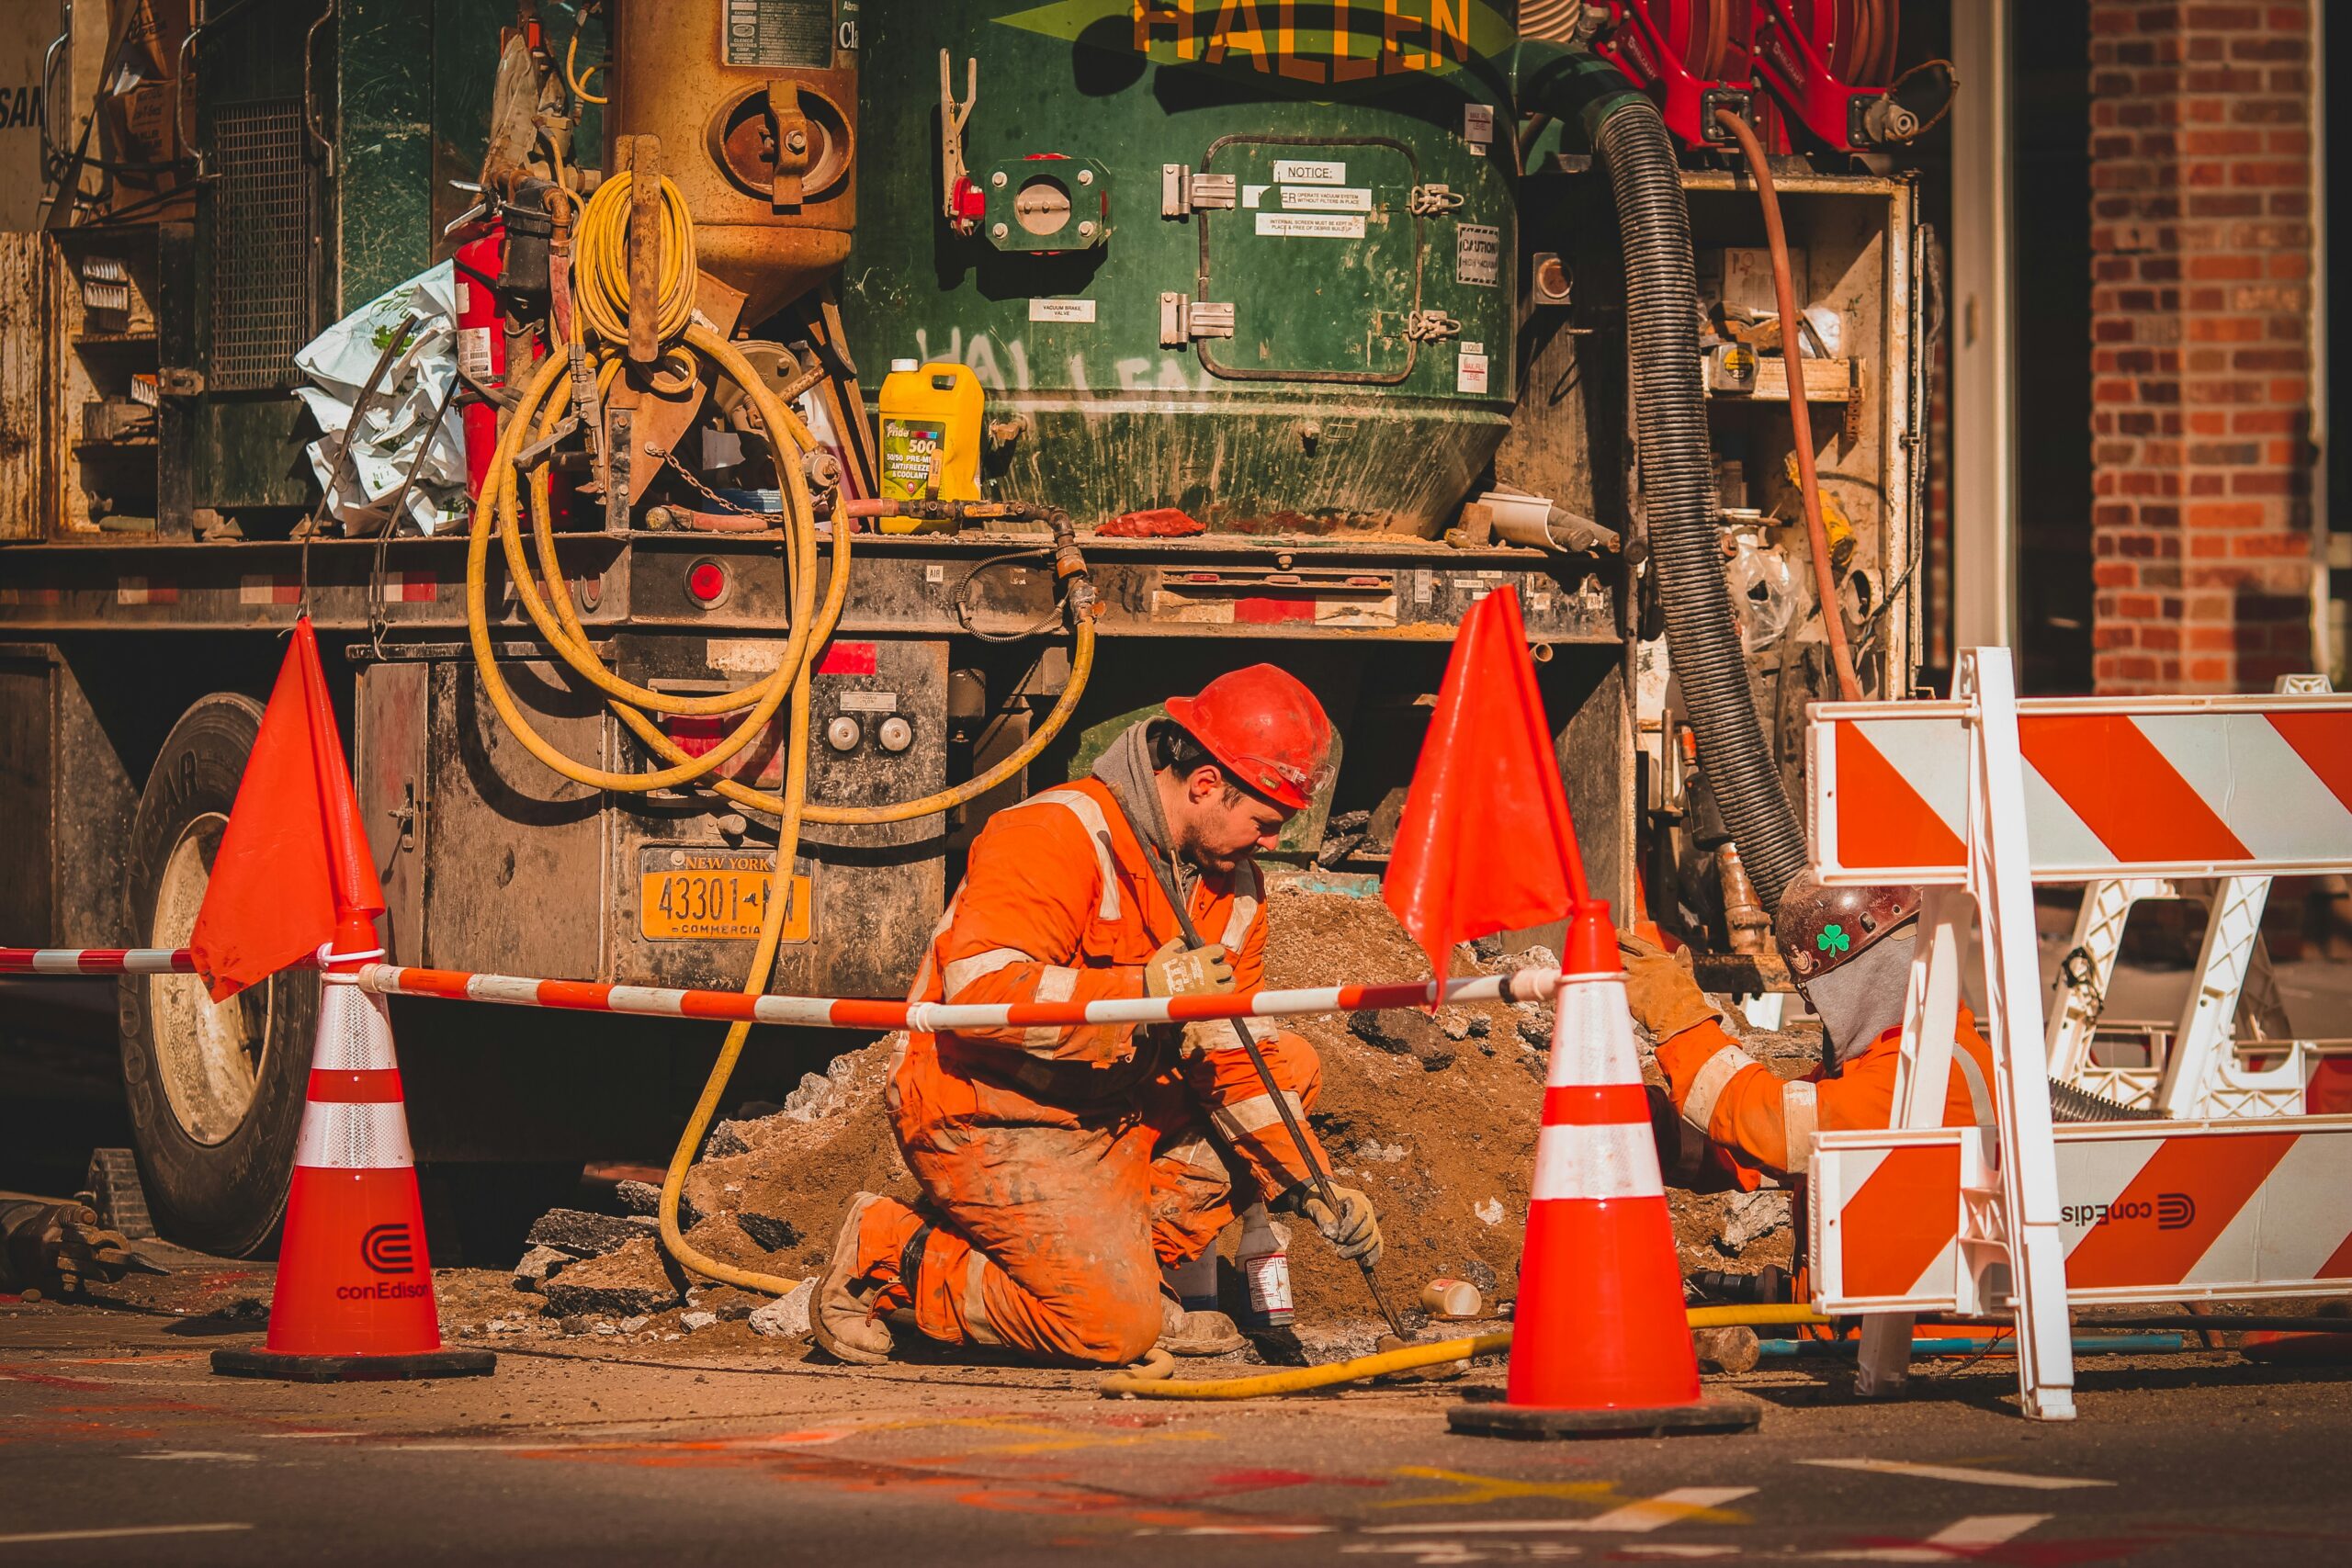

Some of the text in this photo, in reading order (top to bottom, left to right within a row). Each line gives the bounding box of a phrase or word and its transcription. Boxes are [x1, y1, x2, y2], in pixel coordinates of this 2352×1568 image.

[1134, 0, 1468, 85] HALLEN
[1287, 166, 1333, 179] NOTICE:
[1462, 239, 1496, 254] CAUTION
[887, 425, 910, 438] Pride
[908, 439, 937, 455] 500
[887, 453, 932, 463] 50/50 PRE-MI
[891, 463, 930, 472] ANTIFREEZE
[897, 471, 928, 479] COOLANT
[929, 569, 941, 579] AIR
[684, 856, 771, 872] NEW YORK
[681, 924, 761, 935] COMMERCIA
[2061, 1201, 2152, 1227] conEdis
[336, 1281, 428, 1300] conEdison
